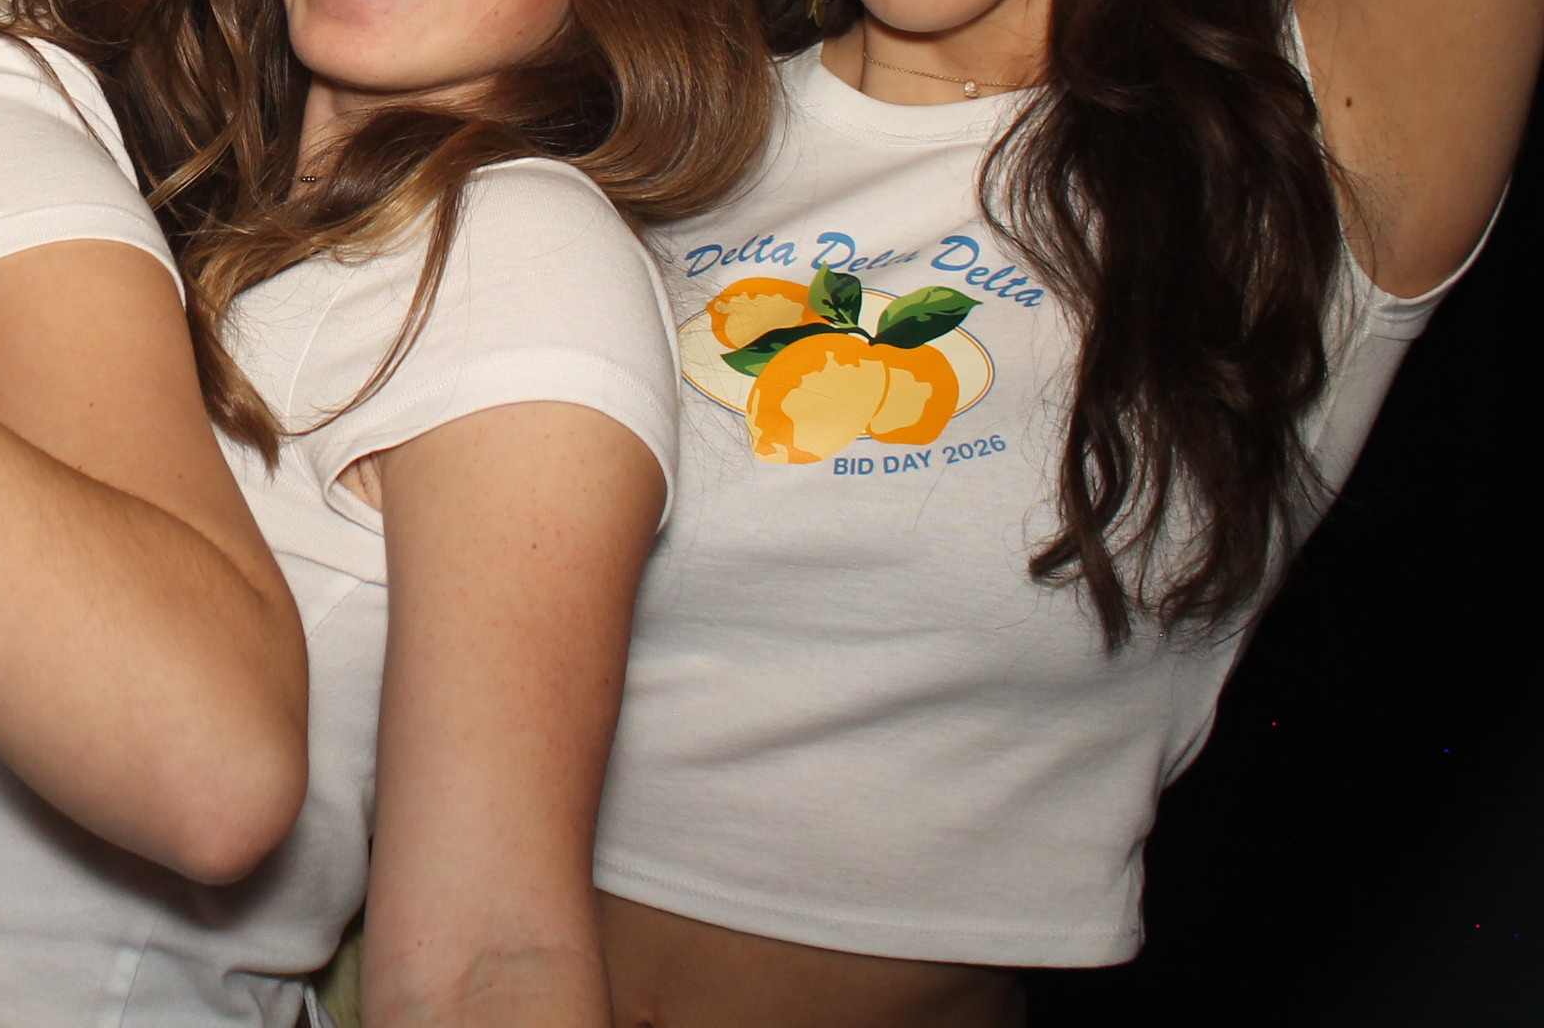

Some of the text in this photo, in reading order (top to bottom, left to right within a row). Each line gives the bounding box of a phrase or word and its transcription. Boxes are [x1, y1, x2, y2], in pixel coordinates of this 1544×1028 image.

[684, 234, 797, 277] Delta
[930, 234, 1045, 308] Delta
[833, 434, 1007, 476] BID DAY 2026
